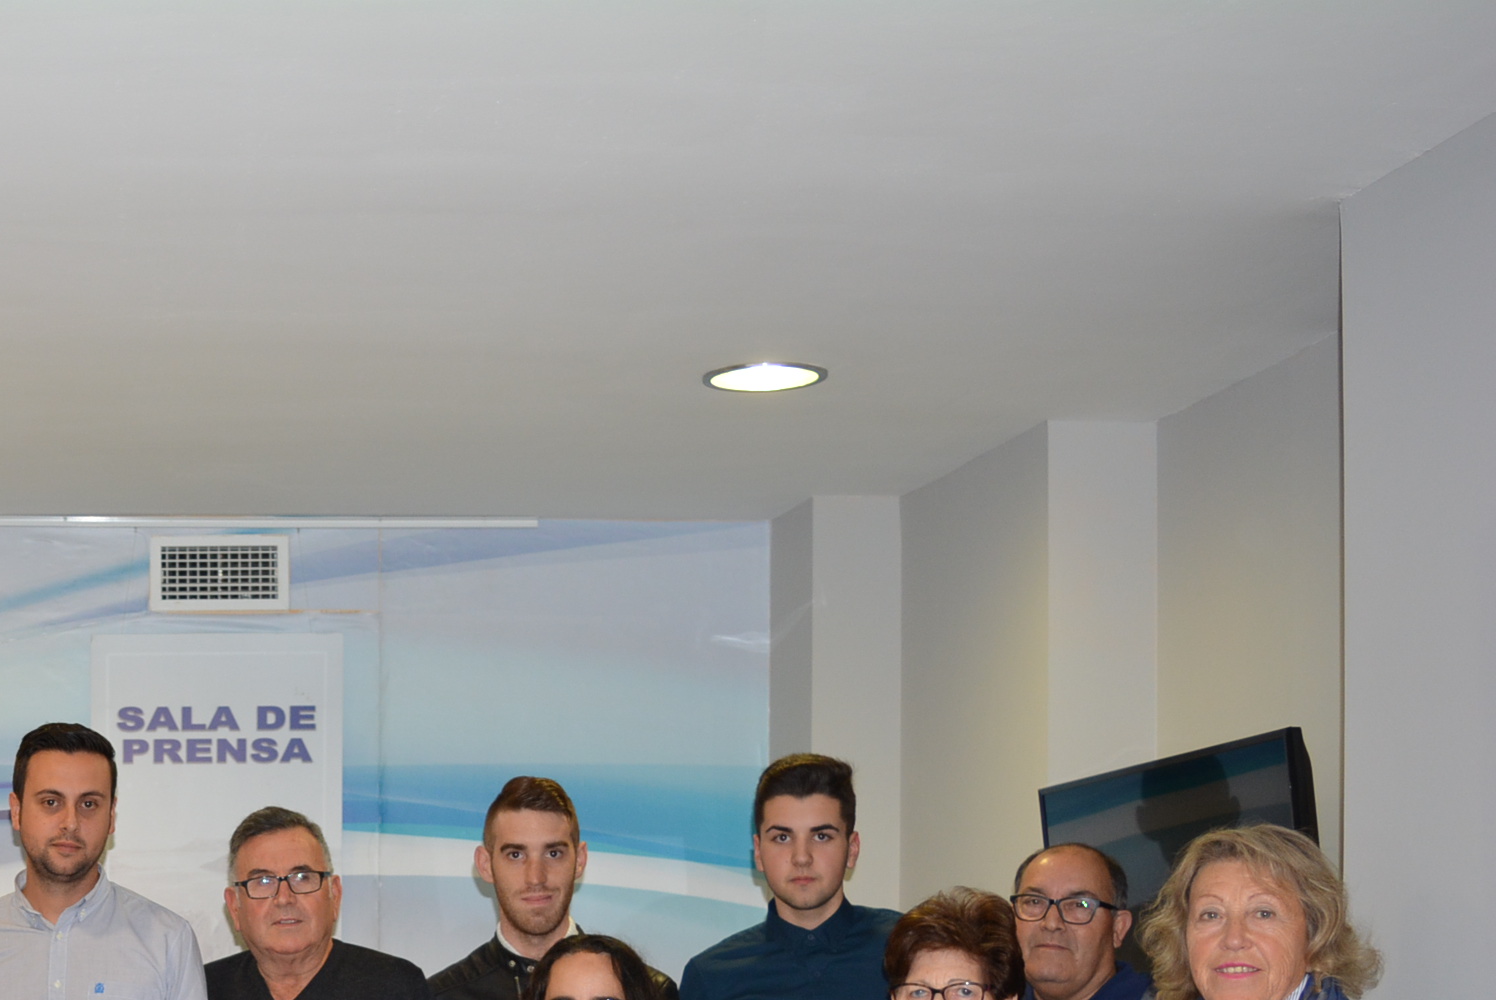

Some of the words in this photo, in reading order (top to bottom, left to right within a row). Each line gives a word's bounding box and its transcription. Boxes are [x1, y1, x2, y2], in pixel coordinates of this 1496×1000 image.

[116, 705, 241, 732] SALA
[256, 705, 317, 731] DE
[122, 737, 313, 764] PRENSA
